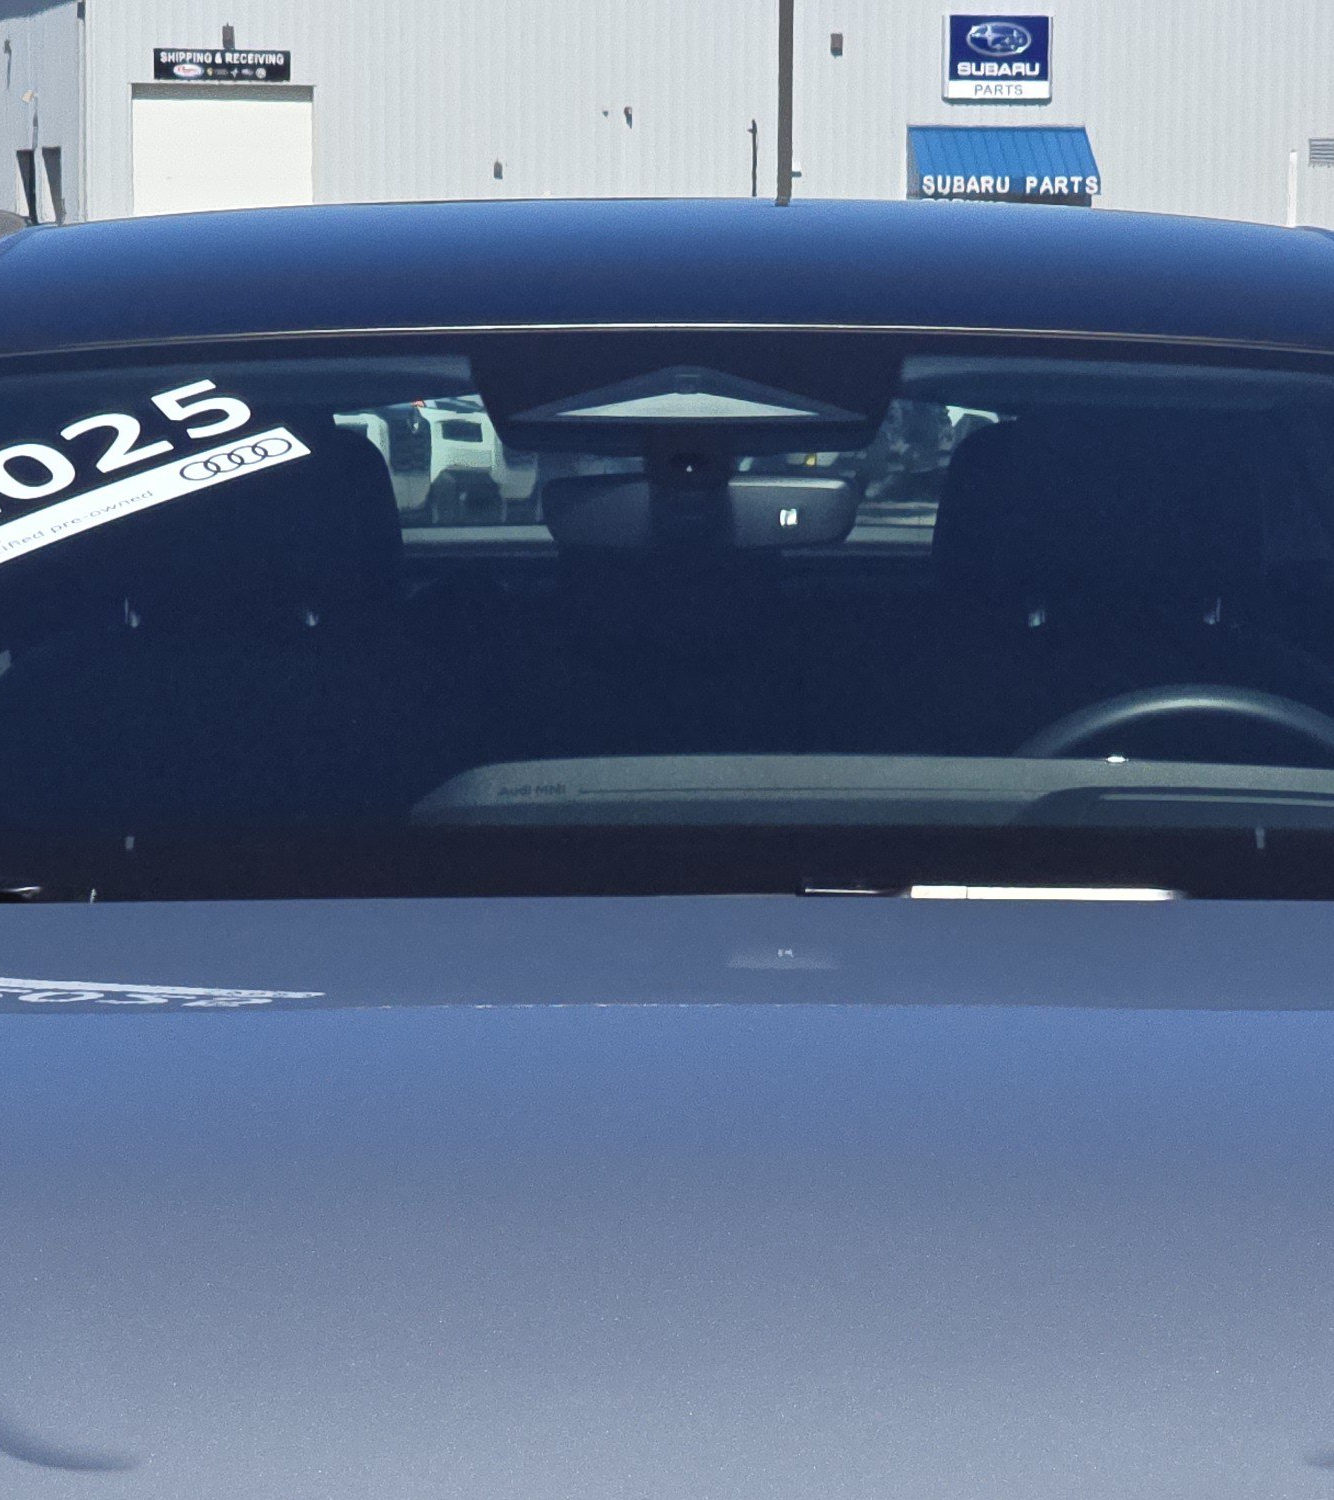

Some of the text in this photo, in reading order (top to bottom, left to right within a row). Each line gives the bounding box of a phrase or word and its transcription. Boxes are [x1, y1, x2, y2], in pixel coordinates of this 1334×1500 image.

[160, 51, 284, 65] SHIPPING & RECEIVING
[957, 62, 1040, 76] SUBARU
[974, 84, 1023, 96] PARTS
[922, 175, 1099, 195] SUBARU PARTS
[50, 490, 154, 534] pre-owned
